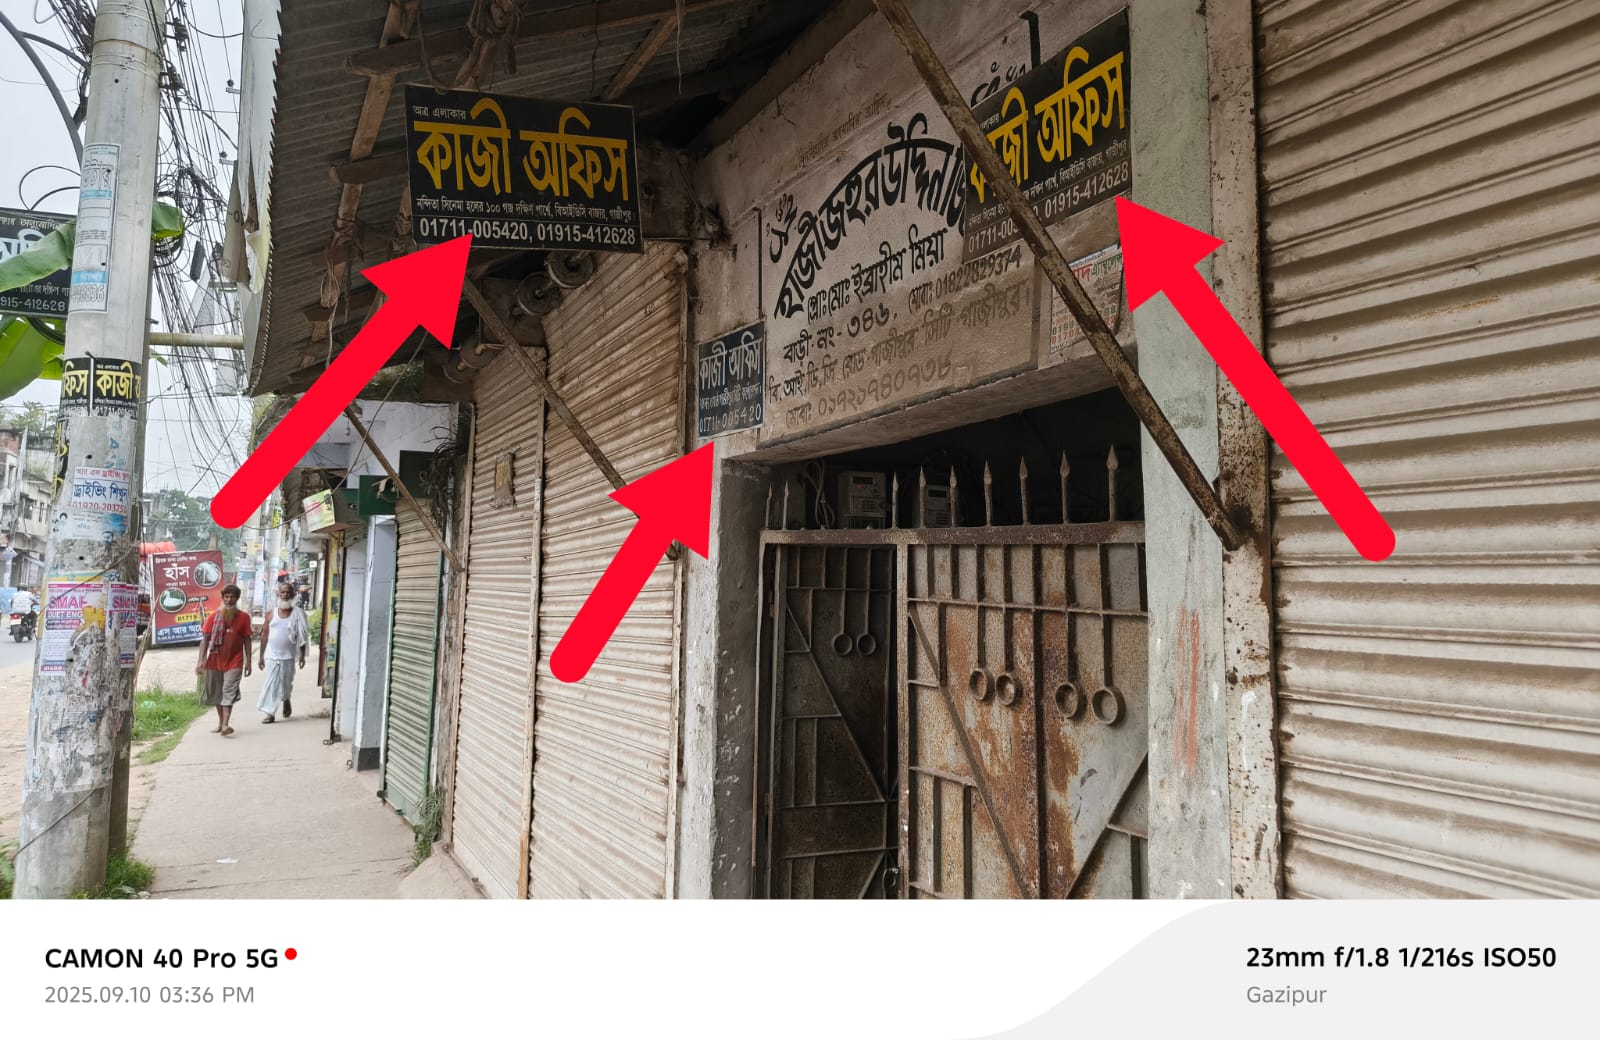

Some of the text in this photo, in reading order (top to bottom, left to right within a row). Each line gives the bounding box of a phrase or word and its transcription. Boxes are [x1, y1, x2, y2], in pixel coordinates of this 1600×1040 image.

[1033, 46, 1125, 163] অফিস
[413, 97, 629, 201] কাজী অফিস
[1045, 161, 1129, 218] 01915-412628
[420, 218, 636, 245] 01711-005420, 01915-412628
[62, 360, 89, 398] ফিস
[95, 361, 134, 399] কাজী
[699, 330, 763, 390] কাজী অফিস
[699, 403, 762, 433] 01711-005420
[74, 480, 107, 500] ড্রাইভিং
[163, 562, 191, 581] হাঁস
